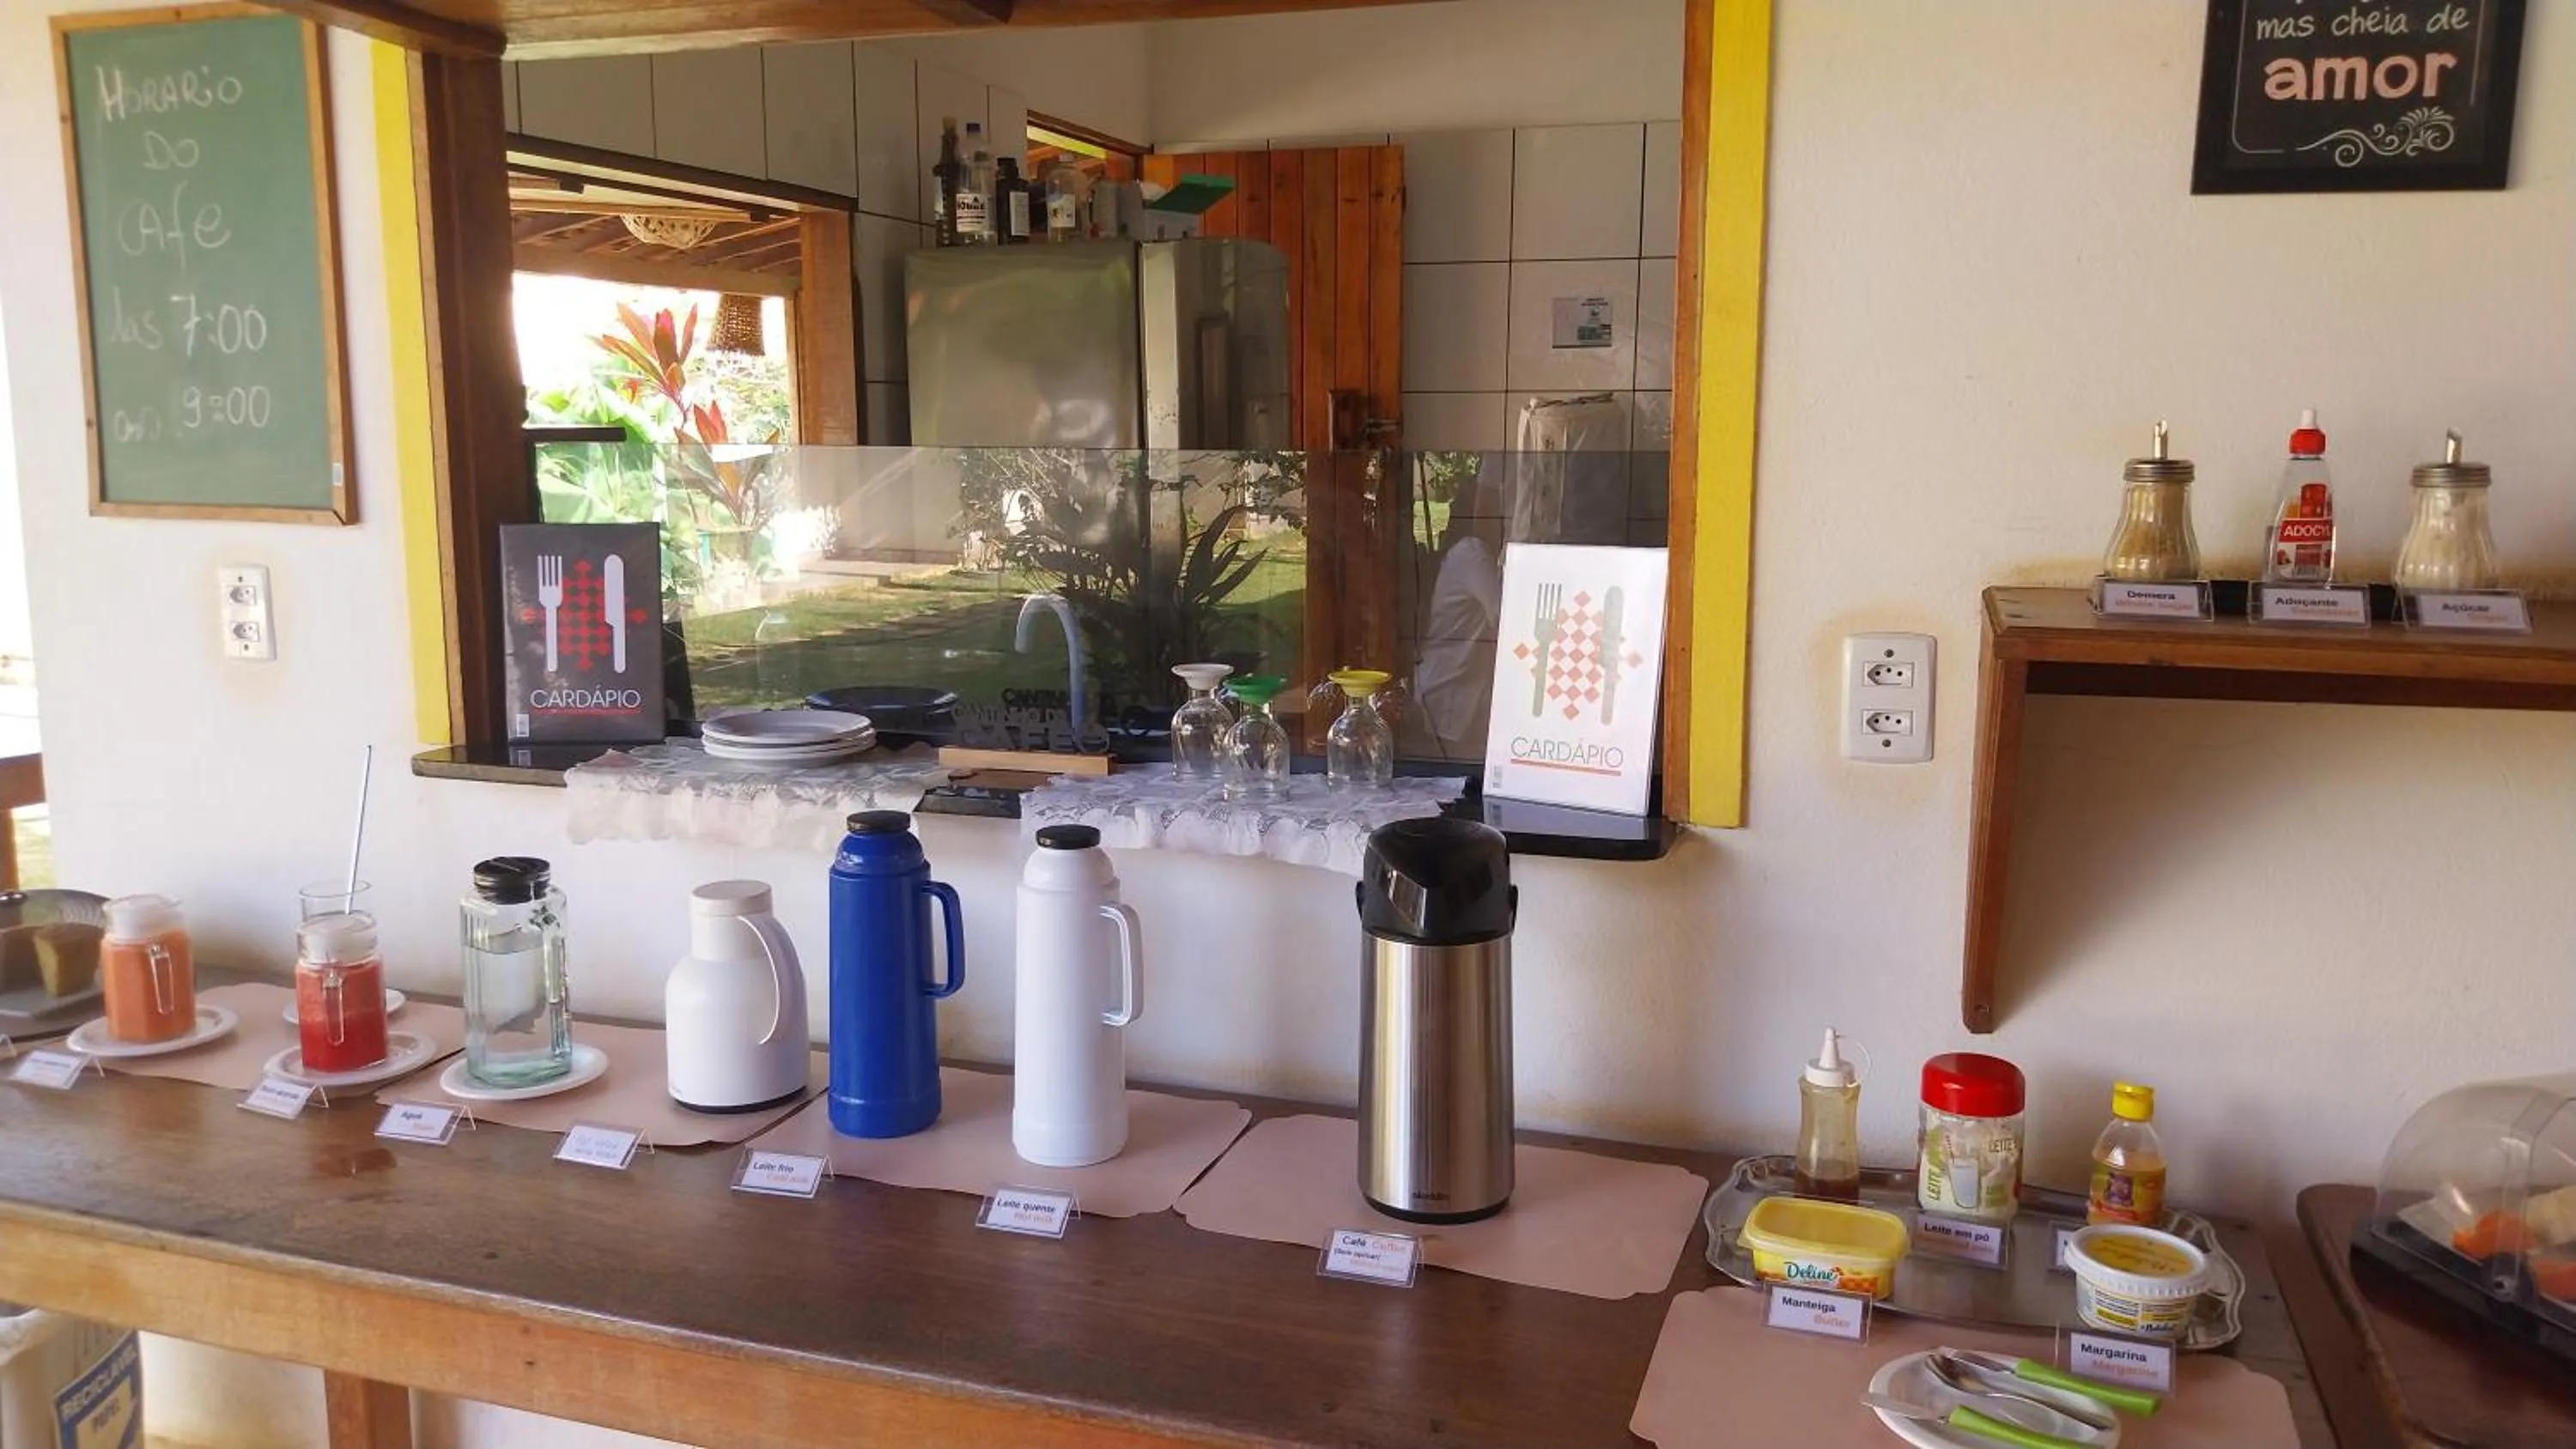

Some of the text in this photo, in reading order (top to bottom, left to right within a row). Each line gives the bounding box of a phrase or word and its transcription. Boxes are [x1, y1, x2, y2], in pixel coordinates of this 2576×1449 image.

[2257, 3, 2470, 40] mas cheia de
[2263, 52, 2458, 100] amor
[170, 293, 267, 356] 7:00
[530, 684, 642, 708] CARDÁPIO
[1510, 736, 1625, 768] CARDÁPIO
[997, 1198, 1021, 1210] Leite
[1342, 1236, 1367, 1247] Café
[1924, 1222, 1990, 1241] Leite em pó
[1783, 1261, 1837, 1282] Deline
[1782, 1295, 1837, 1313] Manteiga
[2081, 1343, 2148, 1362] Margarina
